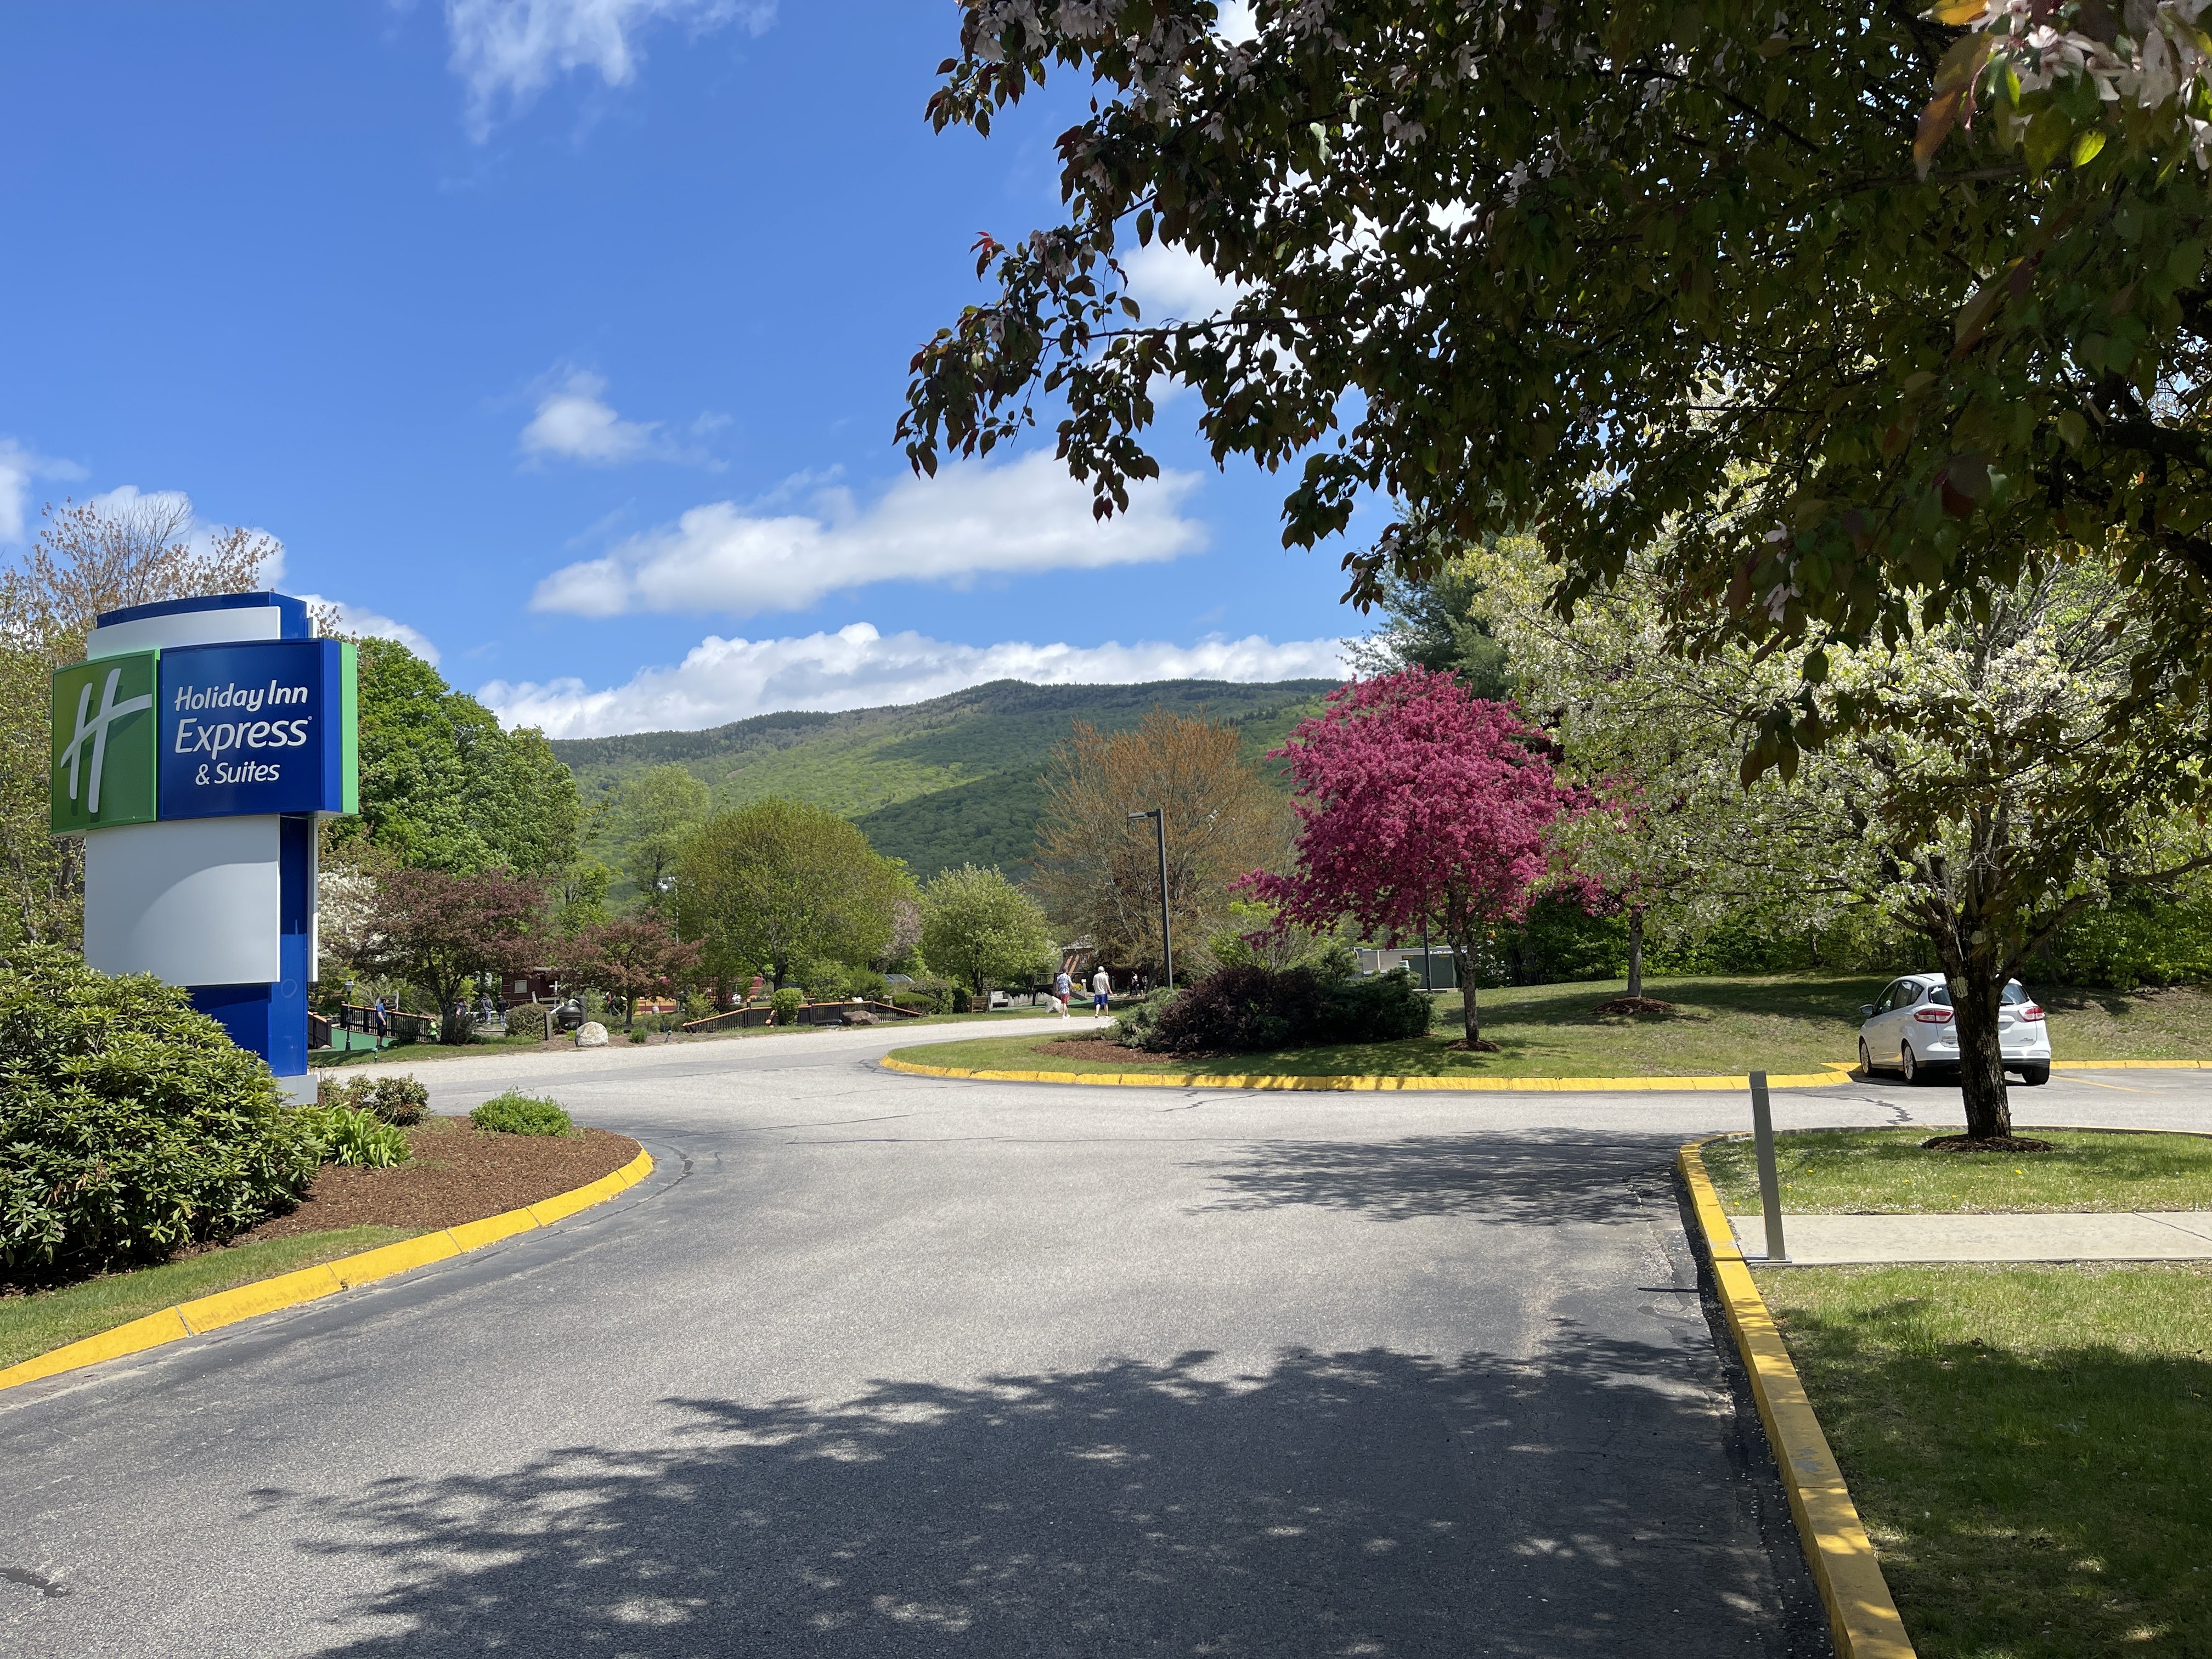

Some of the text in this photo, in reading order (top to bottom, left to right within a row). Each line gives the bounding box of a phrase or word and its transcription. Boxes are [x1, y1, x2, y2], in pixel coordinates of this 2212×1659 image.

[174, 680, 308, 712] Holiday Inn
[175, 718, 308, 761] Express
[195, 761, 280, 786] & Suites
